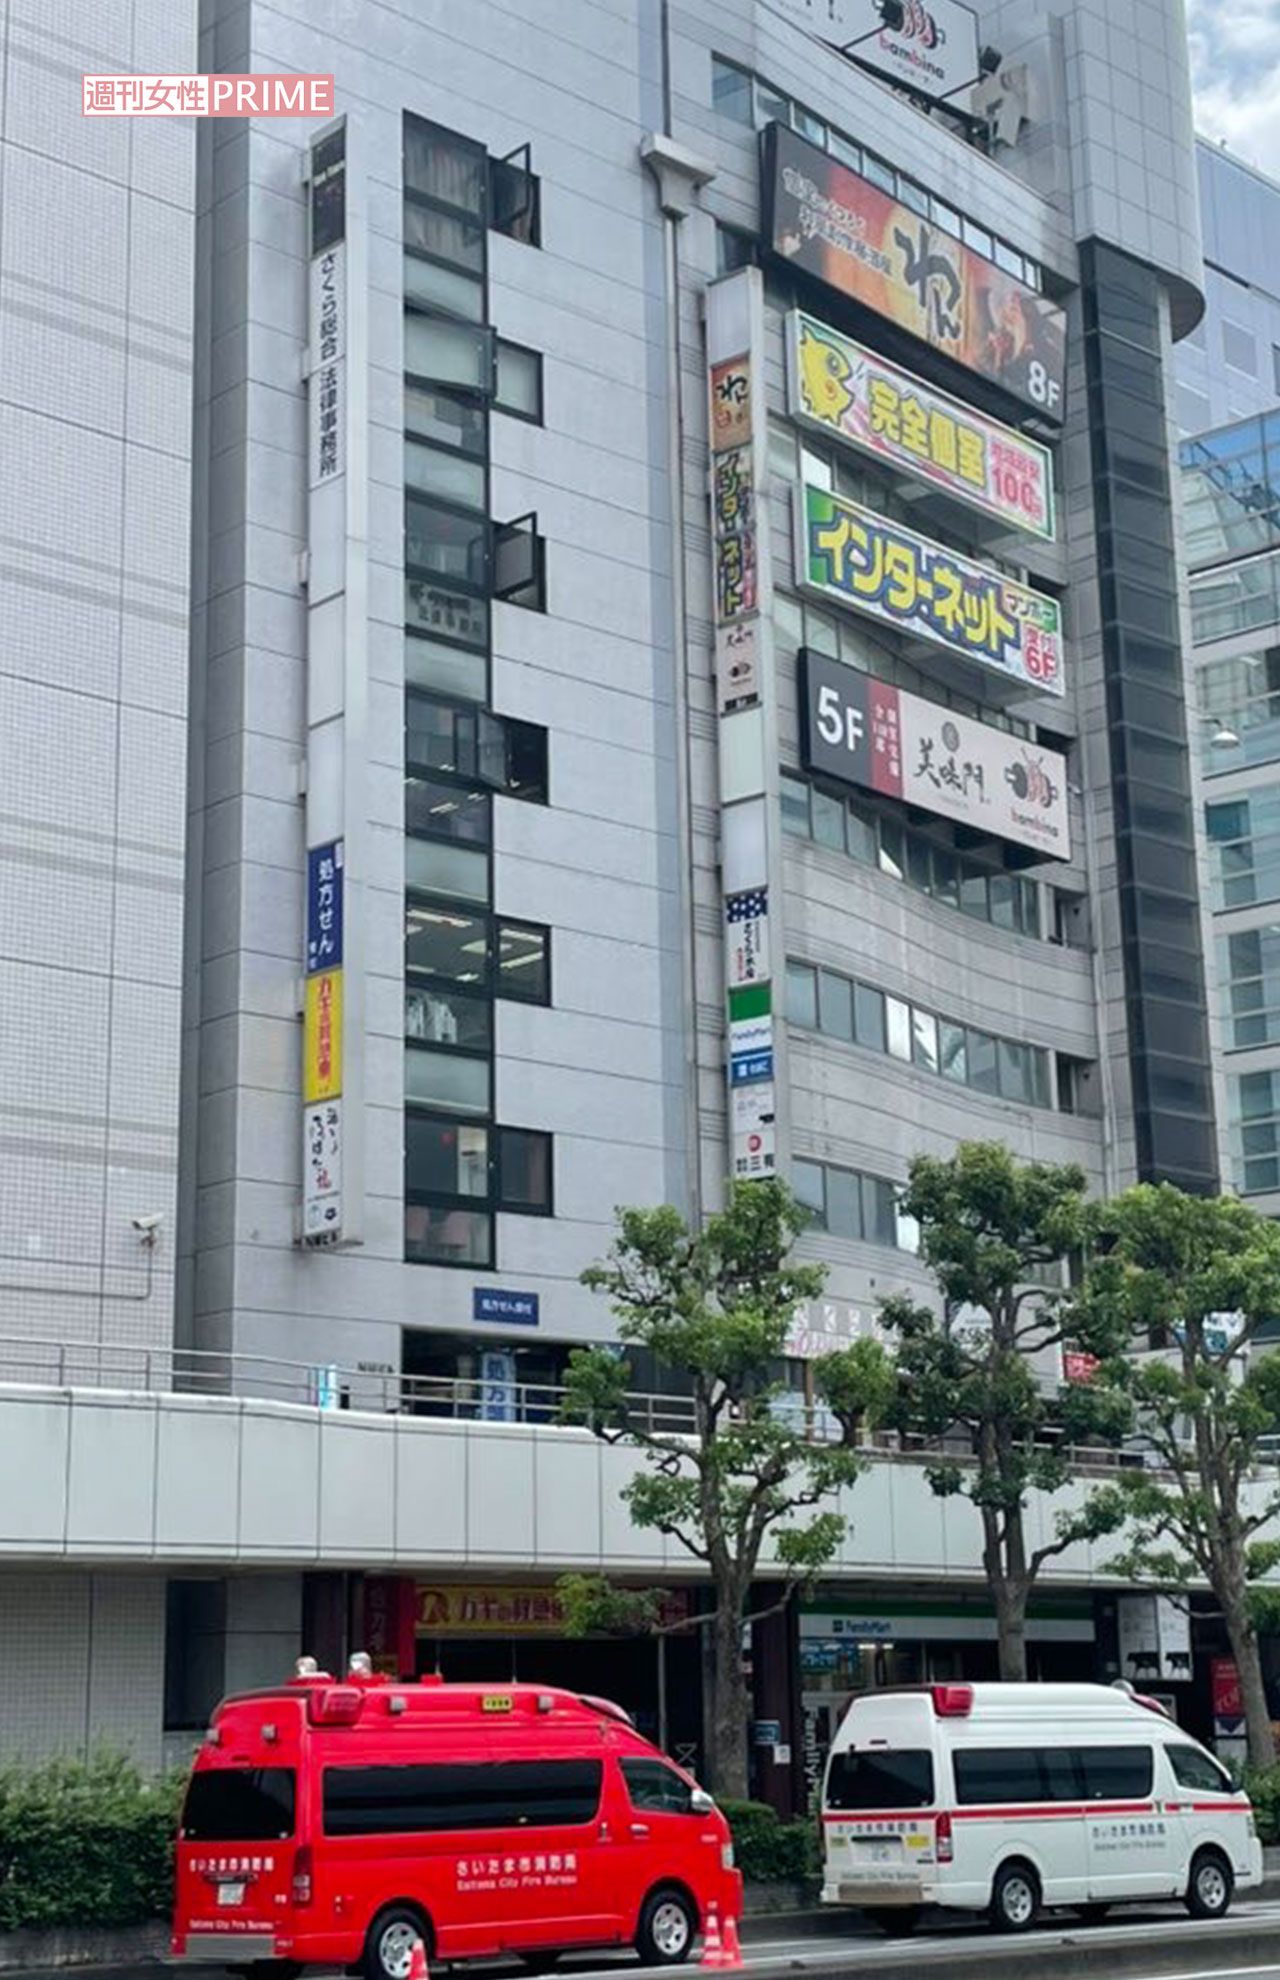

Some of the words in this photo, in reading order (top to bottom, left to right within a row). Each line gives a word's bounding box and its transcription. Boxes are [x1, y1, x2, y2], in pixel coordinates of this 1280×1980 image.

[894, 224, 961, 340] わん
[1028, 360, 1060, 407] 8F
[870, 378, 985, 489] 完全個室
[817, 517, 1015, 652] インターネット
[1026, 646, 1055, 678] 6F
[817, 686, 863, 751] 5F
[319, 858, 334, 956] 処方せん
[457, 1853, 577, 1877] さいたま市消防局
